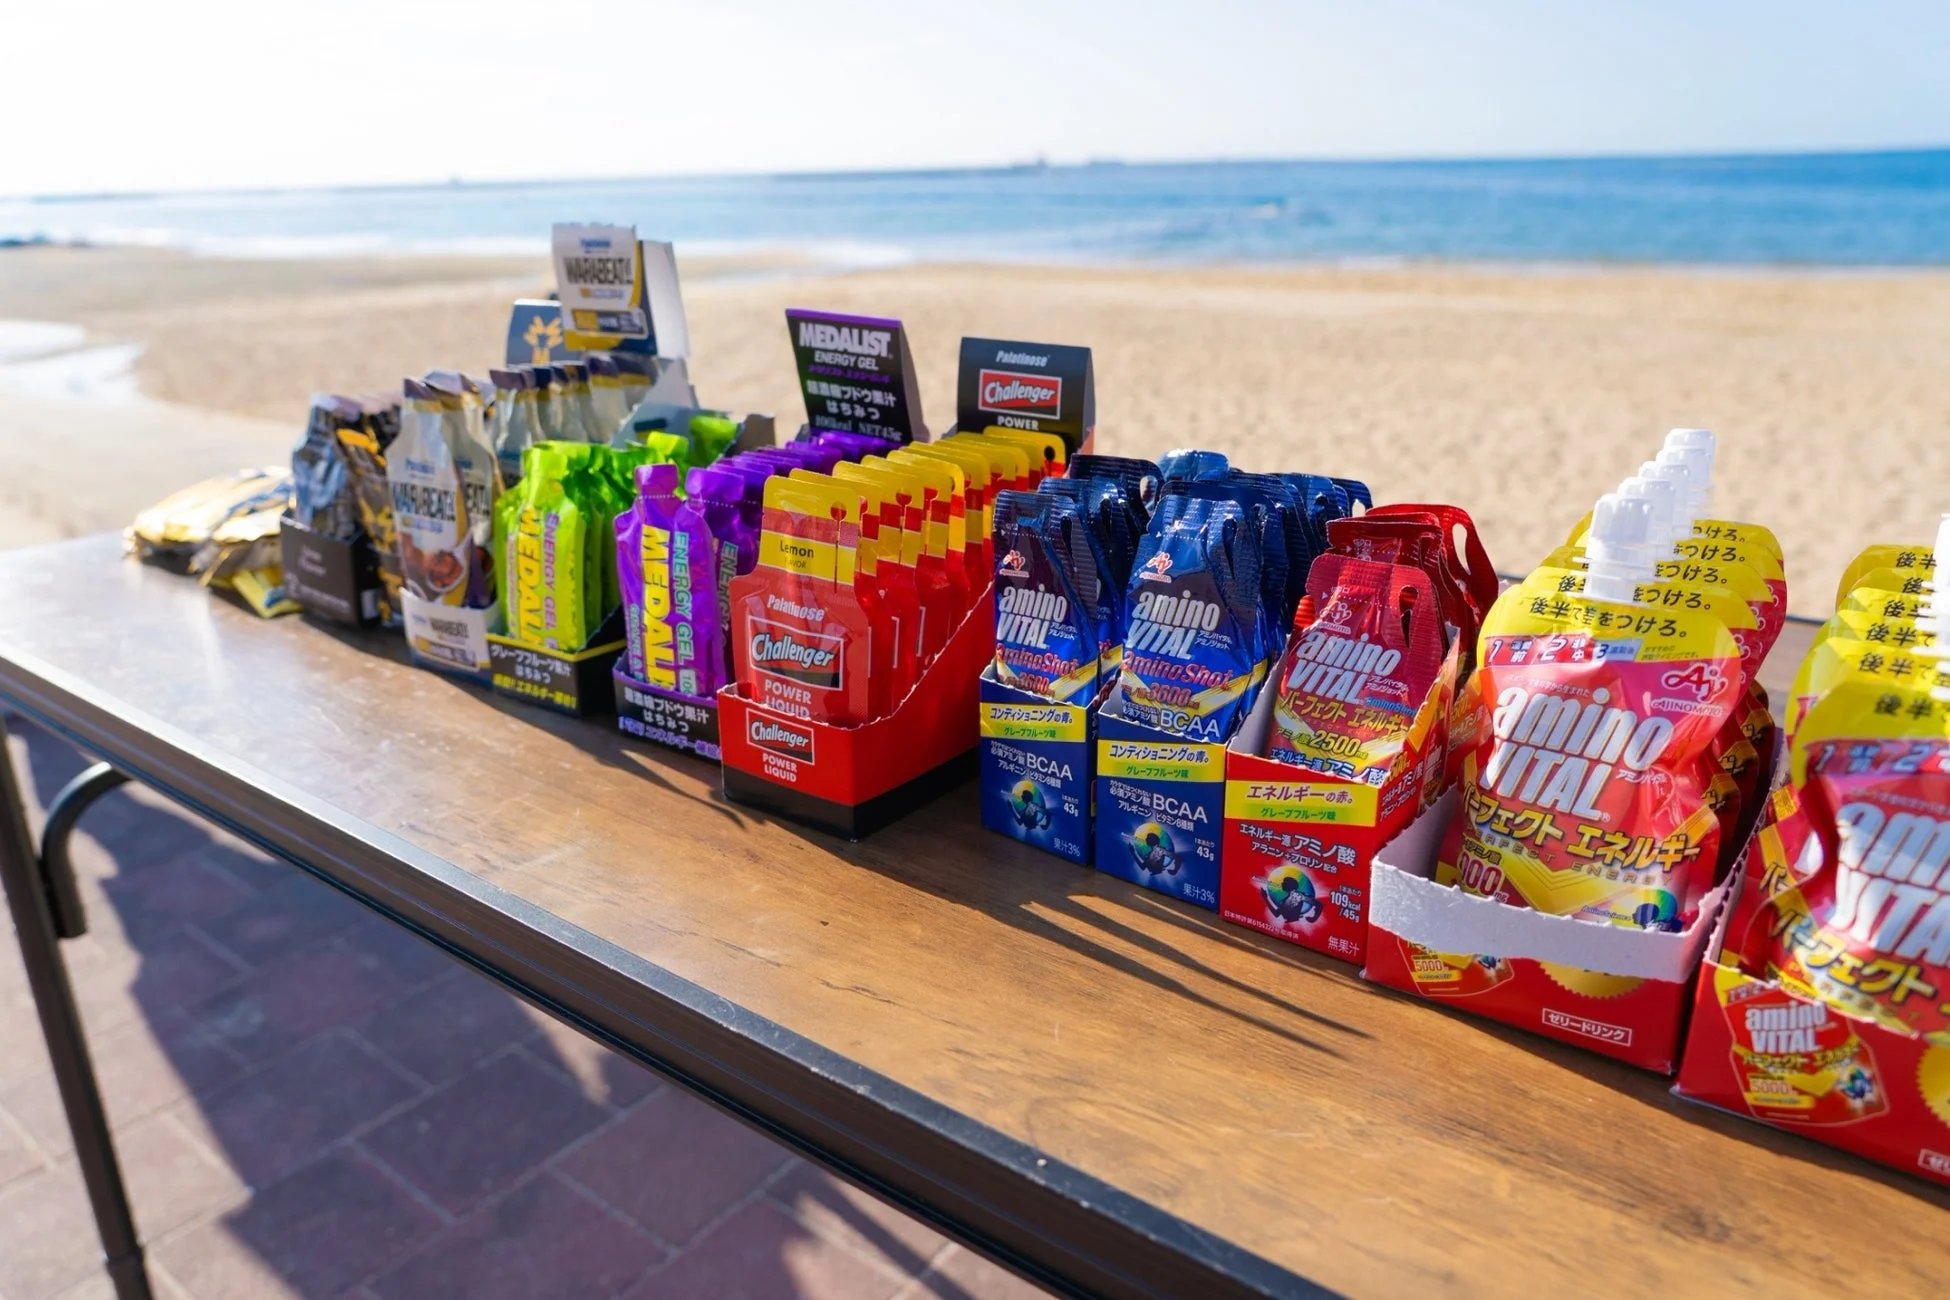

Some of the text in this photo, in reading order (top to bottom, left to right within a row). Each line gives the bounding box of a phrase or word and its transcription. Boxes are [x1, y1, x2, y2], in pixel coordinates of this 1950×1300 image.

[800, 322, 891, 357] MEDALIST
[814, 350, 879, 371] ENERGY GEL
[996, 350, 1048, 367] Palatinose
[983, 380, 1056, 404] Challenger
[826, 399, 881, 420] はちみつ
[997, 415, 1039, 431] POWER
[780, 540, 814, 558] Lemon
[543, 513, 560, 630] ENERGY GEL
[673, 530, 693, 621] ENERGY
[1902, 577, 1935, 594] 後
[767, 594, 824, 621] Palatinose
[998, 584, 1068, 623] amino
[1131, 590, 1220, 632] amino
[996, 612, 1049, 649] VITAL
[1125, 619, 1197, 659] VITAL
[675, 622, 695, 665] GEL
[751, 633, 835, 668] Challenger
[1296, 631, 1402, 677] amino
[1488, 639, 1503, 663] 1
[1540, 636, 1568, 661] 2
[1597, 644, 1610, 659] 3
[765, 679, 811, 705] POWER
[1287, 660, 1368, 705] VITAL
[765, 695, 811, 719] LIQUID
[990, 707, 1073, 724] コンディショニングの青。
[1651, 697, 1724, 717] AJINOMOTO
[643, 709, 690, 732] はちみつ
[1003, 726, 1056, 739] グレープフルーツ味
[1160, 709, 1220, 737] BCAA
[1348, 708, 1410, 736] エネルギー
[1494, 686, 1675, 771] amino
[750, 720, 809, 748] Challenger
[762, 753, 797, 772] POWER
[1026, 752, 1073, 781] BCAA
[1109, 744, 1209, 764] コンディショニングの青。
[1270, 747, 1324, 771] エネルギー源
[764, 764, 797, 782] LIQUID
[1126, 766, 1188, 778] グレープフルーツ味
[1480, 741, 1612, 820] VITAL
[1247, 785, 1353, 804] エネルギーの赤。
[1063, 803, 1079, 817] 43g
[1118, 800, 1194, 833] アルギニン ビタミン8種類
[1153, 793, 1208, 824] BCAA
[1260, 807, 1336, 821] グレープフルーツ味
[1053, 837, 1081, 857] 果汁3%
[1196, 845, 1215, 862] 43g
[1239, 823, 1357, 867] エネルギー源 アミノ酸
[1566, 823, 1702, 872] エネルギー
[1570, 860, 1674, 886] ENERGY
[1183, 883, 1215, 904] 果汁3%
[1330, 891, 1361, 911] 109kcal
[1339, 907, 1360, 923] /45g
[1327, 935, 1360, 957] 無果汁
[1548, 1011, 1626, 1041] ゼリードリンク
[1745, 1000, 1827, 1031] amino
[1750, 1029, 1820, 1054] VITAL
